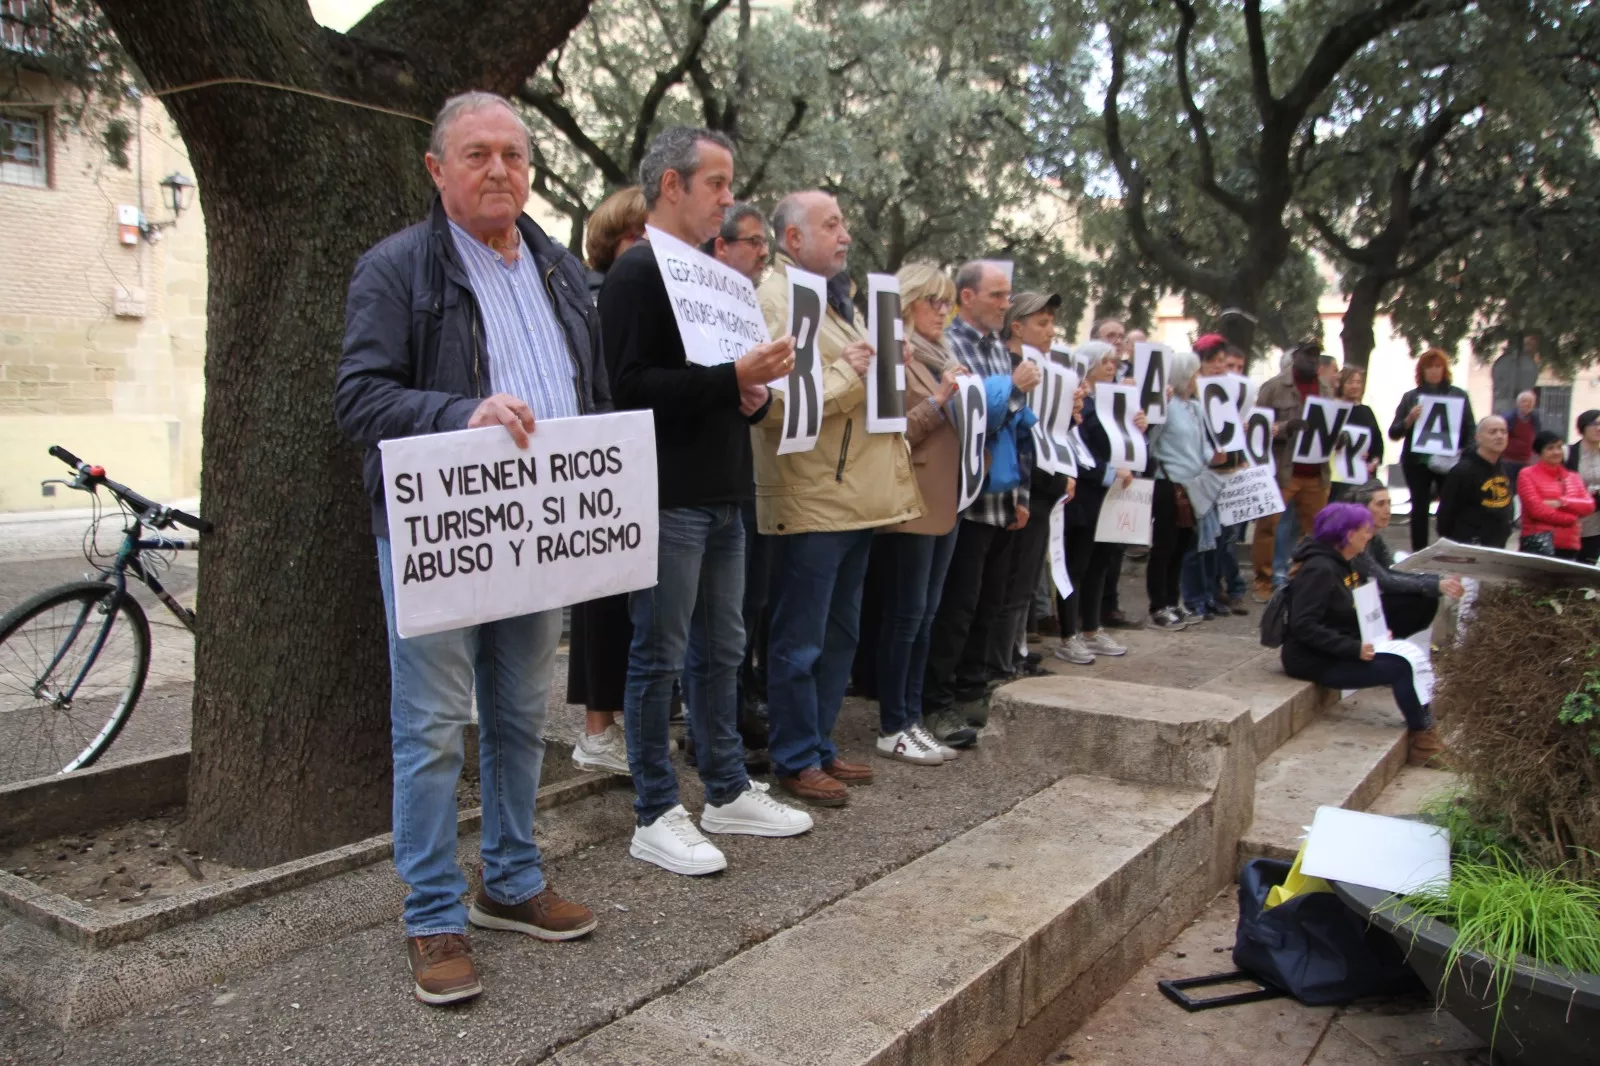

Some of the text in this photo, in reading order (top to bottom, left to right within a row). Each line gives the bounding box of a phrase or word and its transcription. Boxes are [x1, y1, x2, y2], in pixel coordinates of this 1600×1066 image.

[786, 283, 820, 439] R
[877, 291, 907, 419] E
[1140, 351, 1166, 416] A
[964, 384, 985, 499] G
[1204, 383, 1235, 446] C
[1298, 403, 1349, 457] N
[1415, 402, 1453, 450] A
[395, 446, 623, 504] SI VIENEN RICOS
[404, 488, 622, 547] TURISMO, SI NO,
[403, 522, 641, 585] ABUSO Y RACISMO
